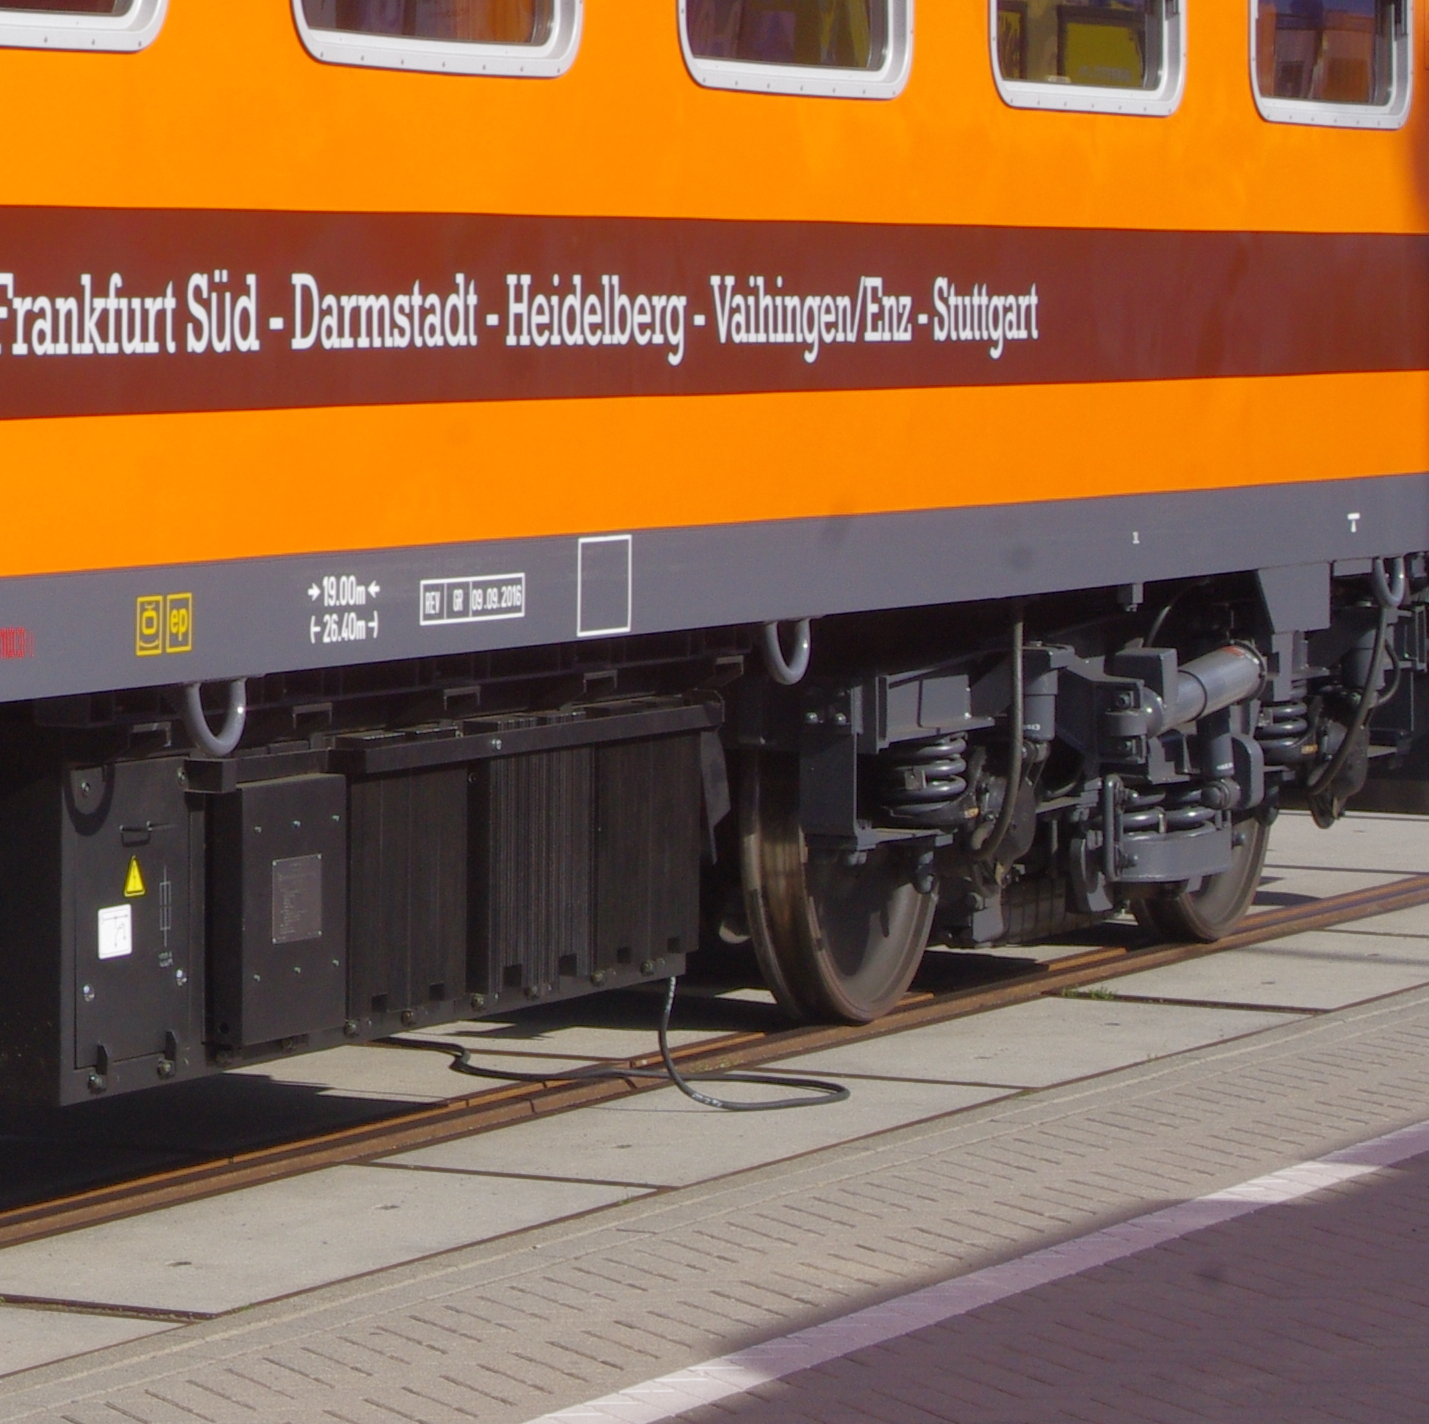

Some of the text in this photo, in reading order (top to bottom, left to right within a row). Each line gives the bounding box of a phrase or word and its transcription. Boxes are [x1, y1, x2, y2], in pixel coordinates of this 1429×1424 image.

[187, 269, 260, 354] Süd
[291, 273, 478, 350] Darmstadt
[506, 274, 687, 366] Heidelberg
[710, 275, 912, 363] Vaihingen/Enz
[934, 276, 1038, 359] Stuttgart
[322, 575, 366, 607] 19.00m
[424, 590, 441, 614] REV
[453, 588, 464, 612] GR
[170, 607, 188, 641] ep
